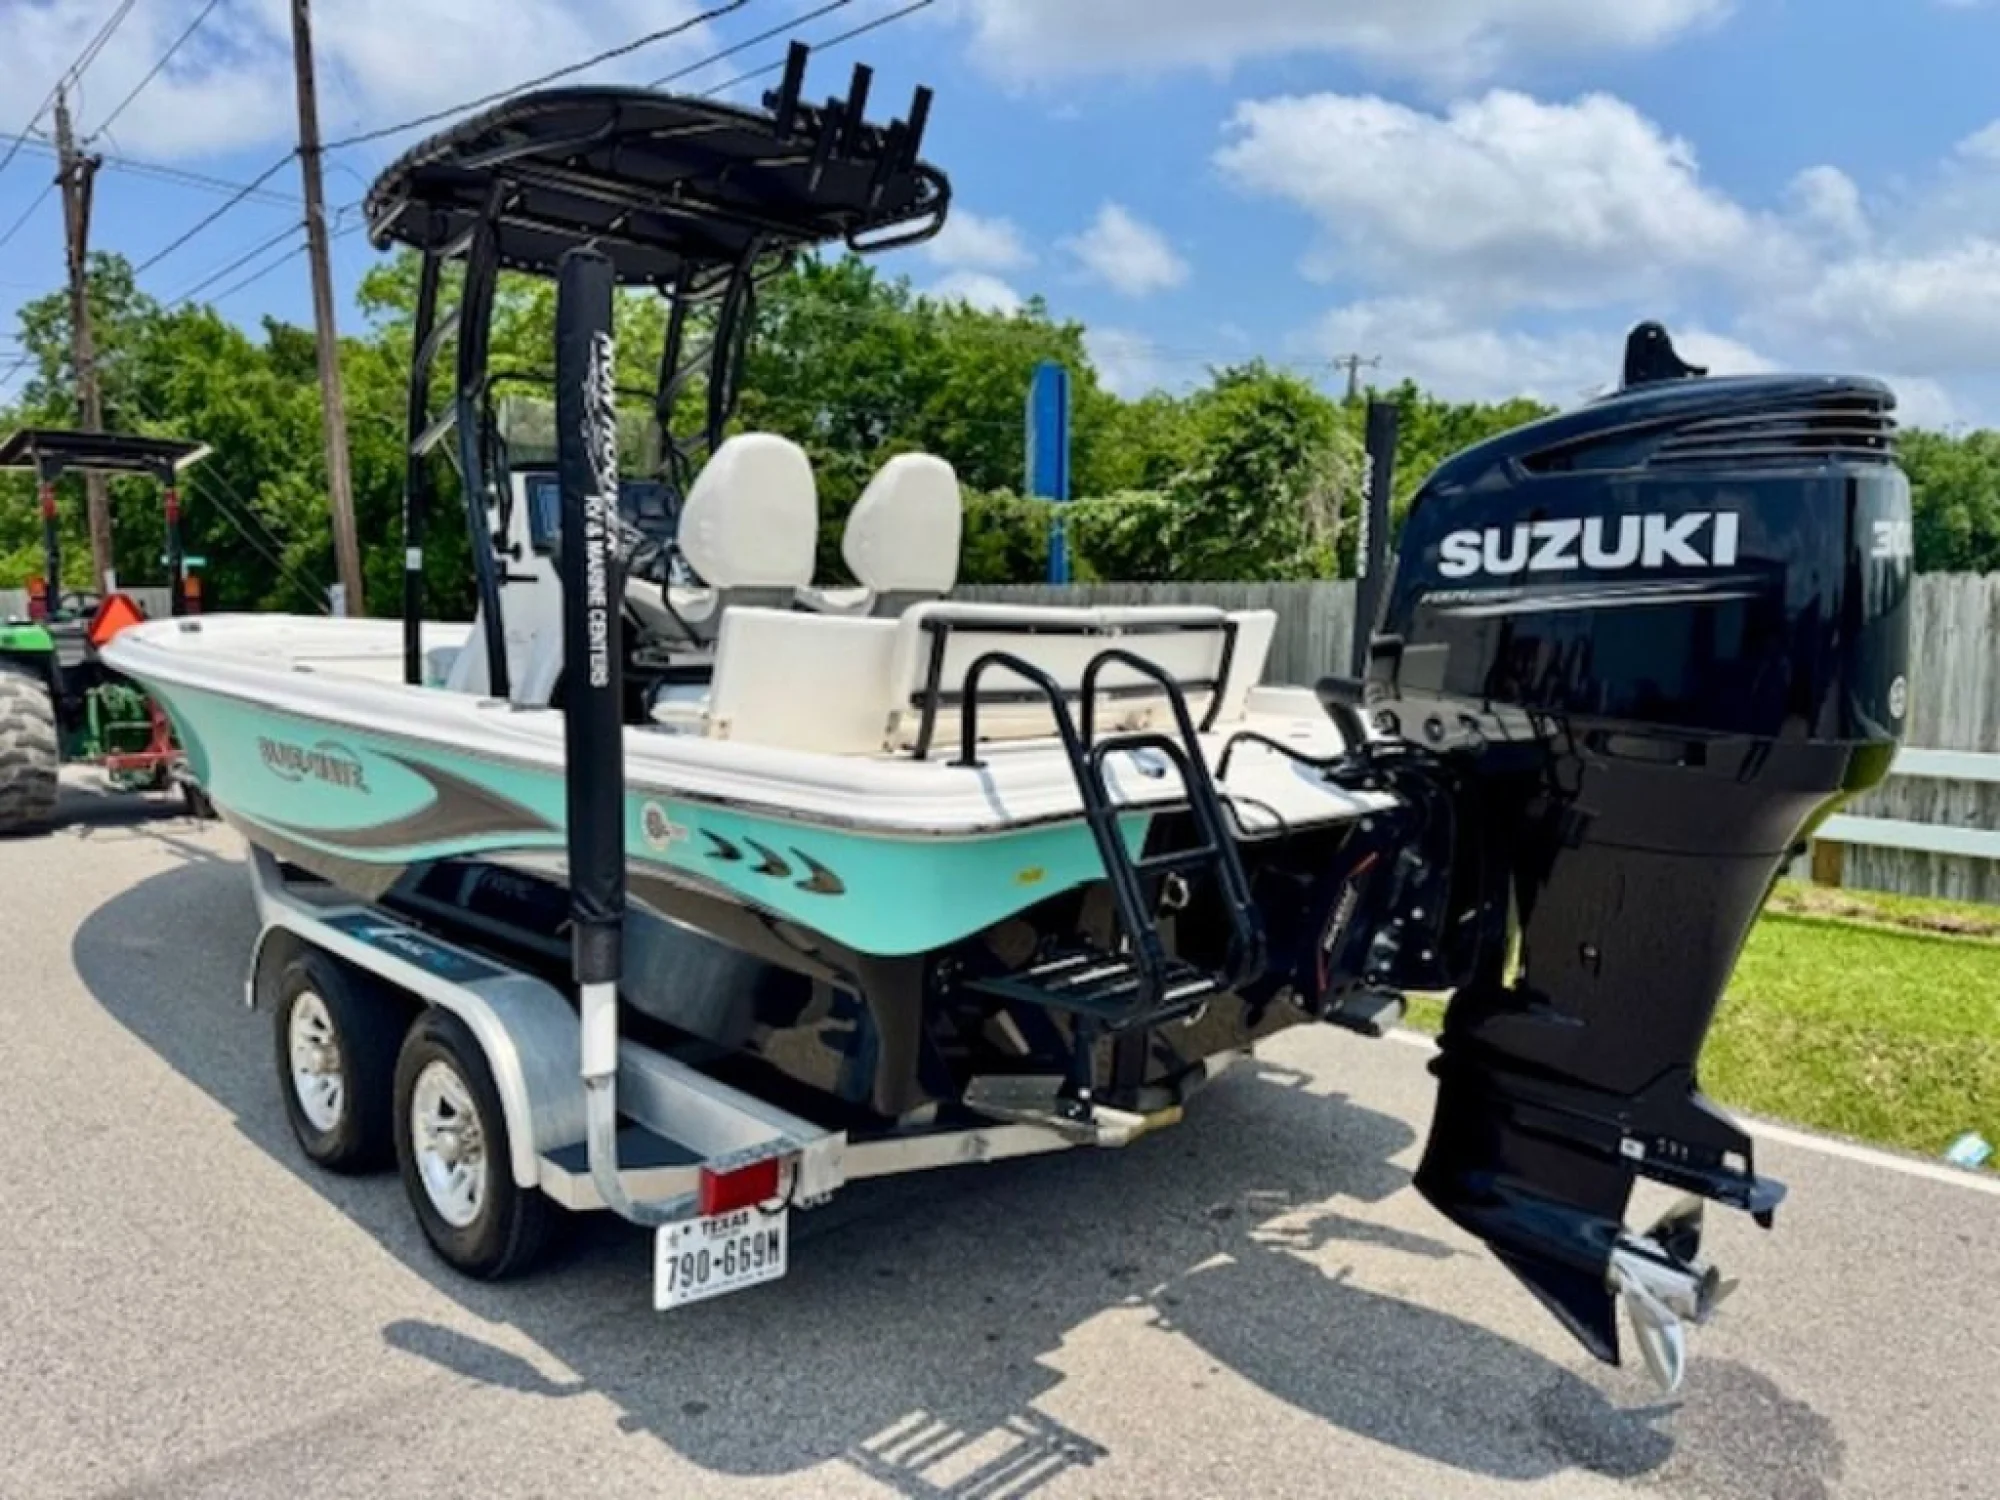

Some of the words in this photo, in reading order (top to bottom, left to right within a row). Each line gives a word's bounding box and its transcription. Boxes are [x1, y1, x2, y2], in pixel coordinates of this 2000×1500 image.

[586, 541, 606, 606] MARINE
[1438, 511, 1738, 578] SUZUKI
[701, 1210, 749, 1236] TEXAS
